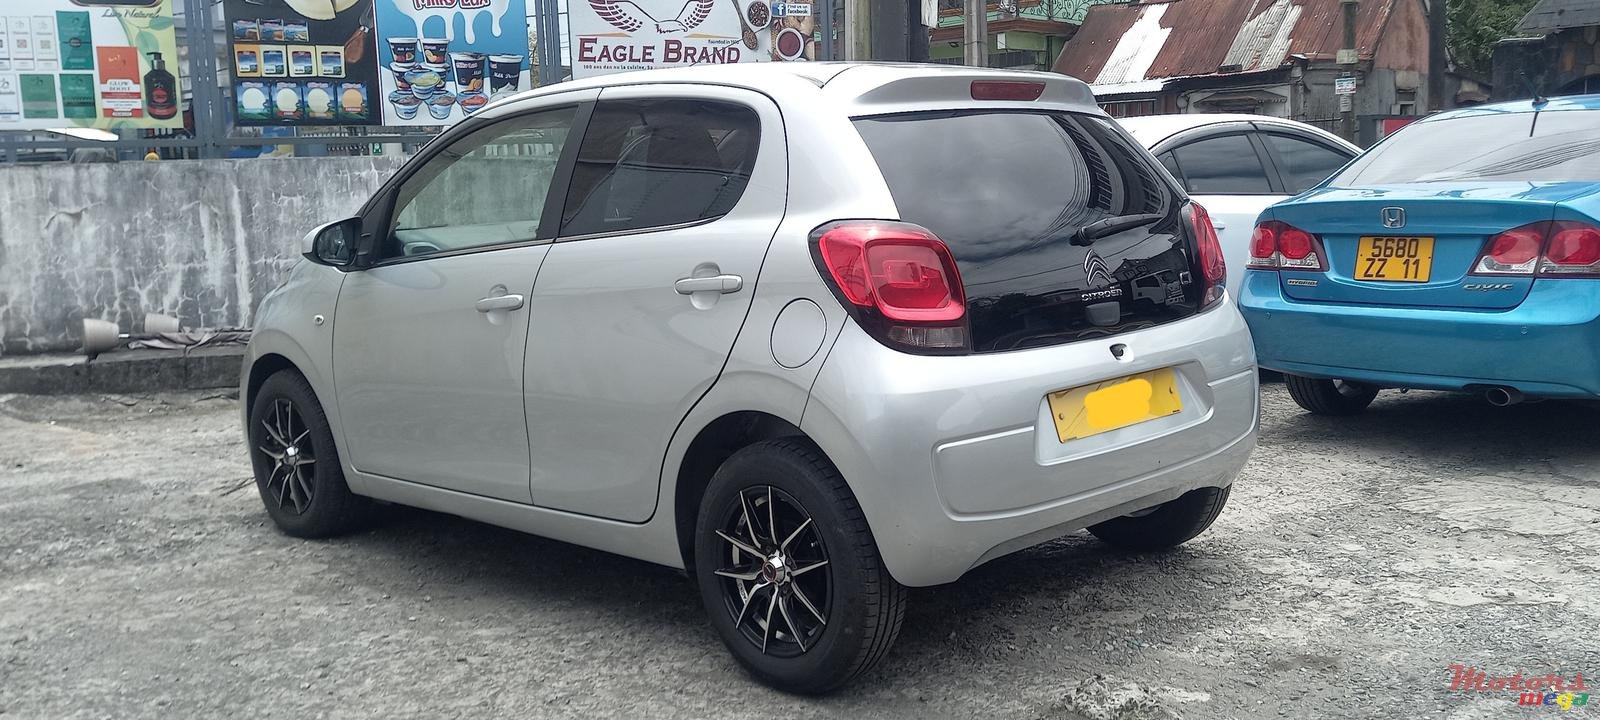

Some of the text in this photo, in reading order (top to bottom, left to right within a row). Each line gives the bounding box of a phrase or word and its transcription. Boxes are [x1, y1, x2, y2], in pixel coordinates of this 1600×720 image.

[578, 38, 741, 64] EAGLE BRAND
[1371, 238, 1419, 258] 5680
[1363, 257, 1420, 279] ZZ 11
[1081, 286, 1123, 302] CITROËN
[1463, 283, 1514, 292] CIVIC
